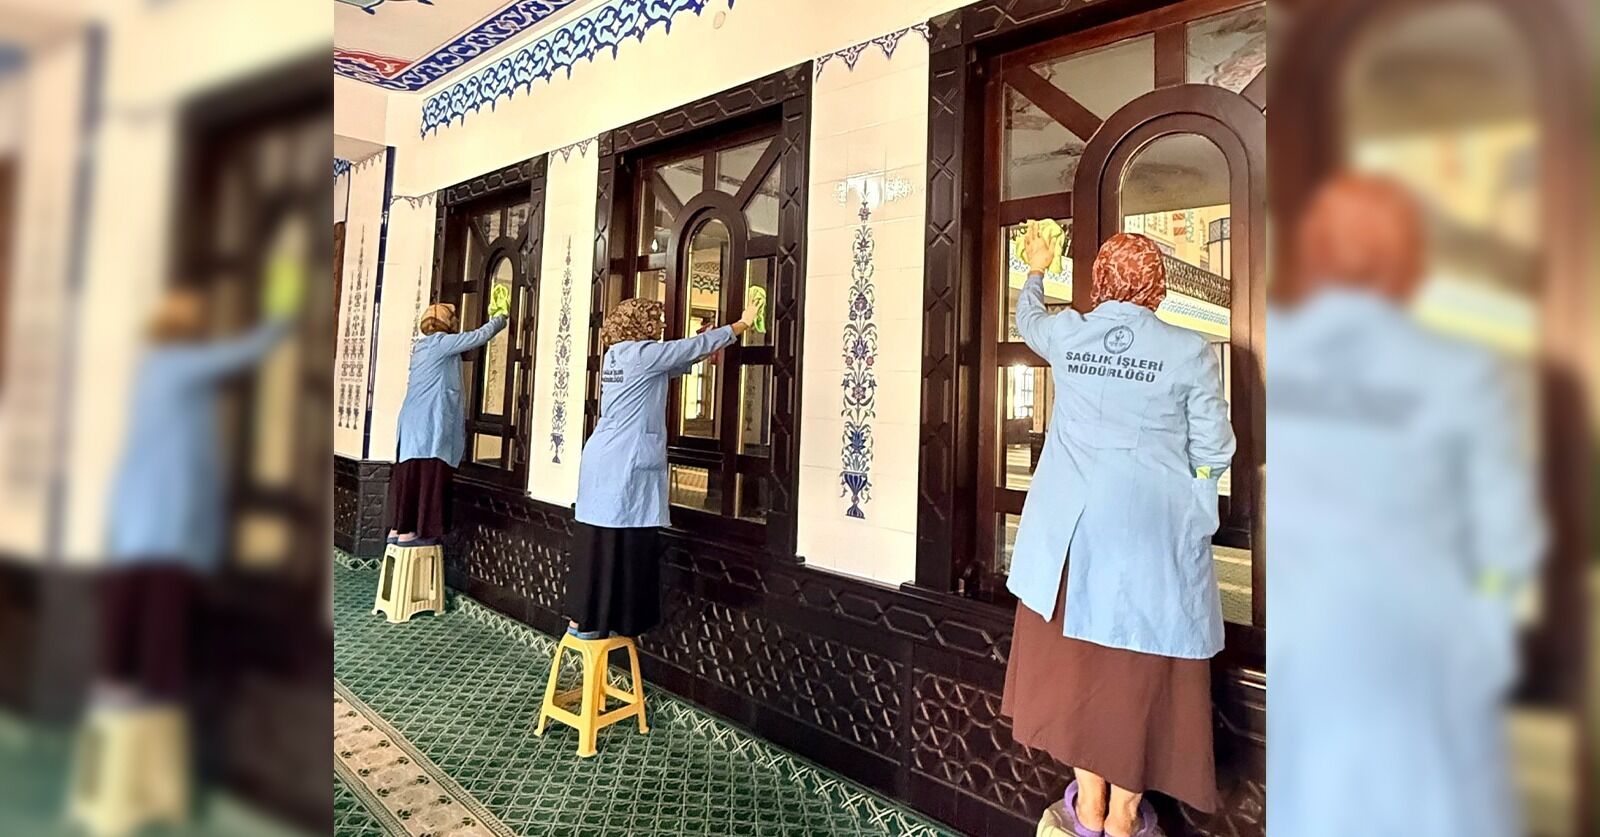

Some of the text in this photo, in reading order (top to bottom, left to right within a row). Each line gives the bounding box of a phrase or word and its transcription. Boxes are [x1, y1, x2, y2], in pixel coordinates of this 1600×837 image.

[1066, 351, 1164, 372] SAĞLIK İŞLERİ
[1067, 364, 1156, 383] MÜDÜRLÜĞÜ
